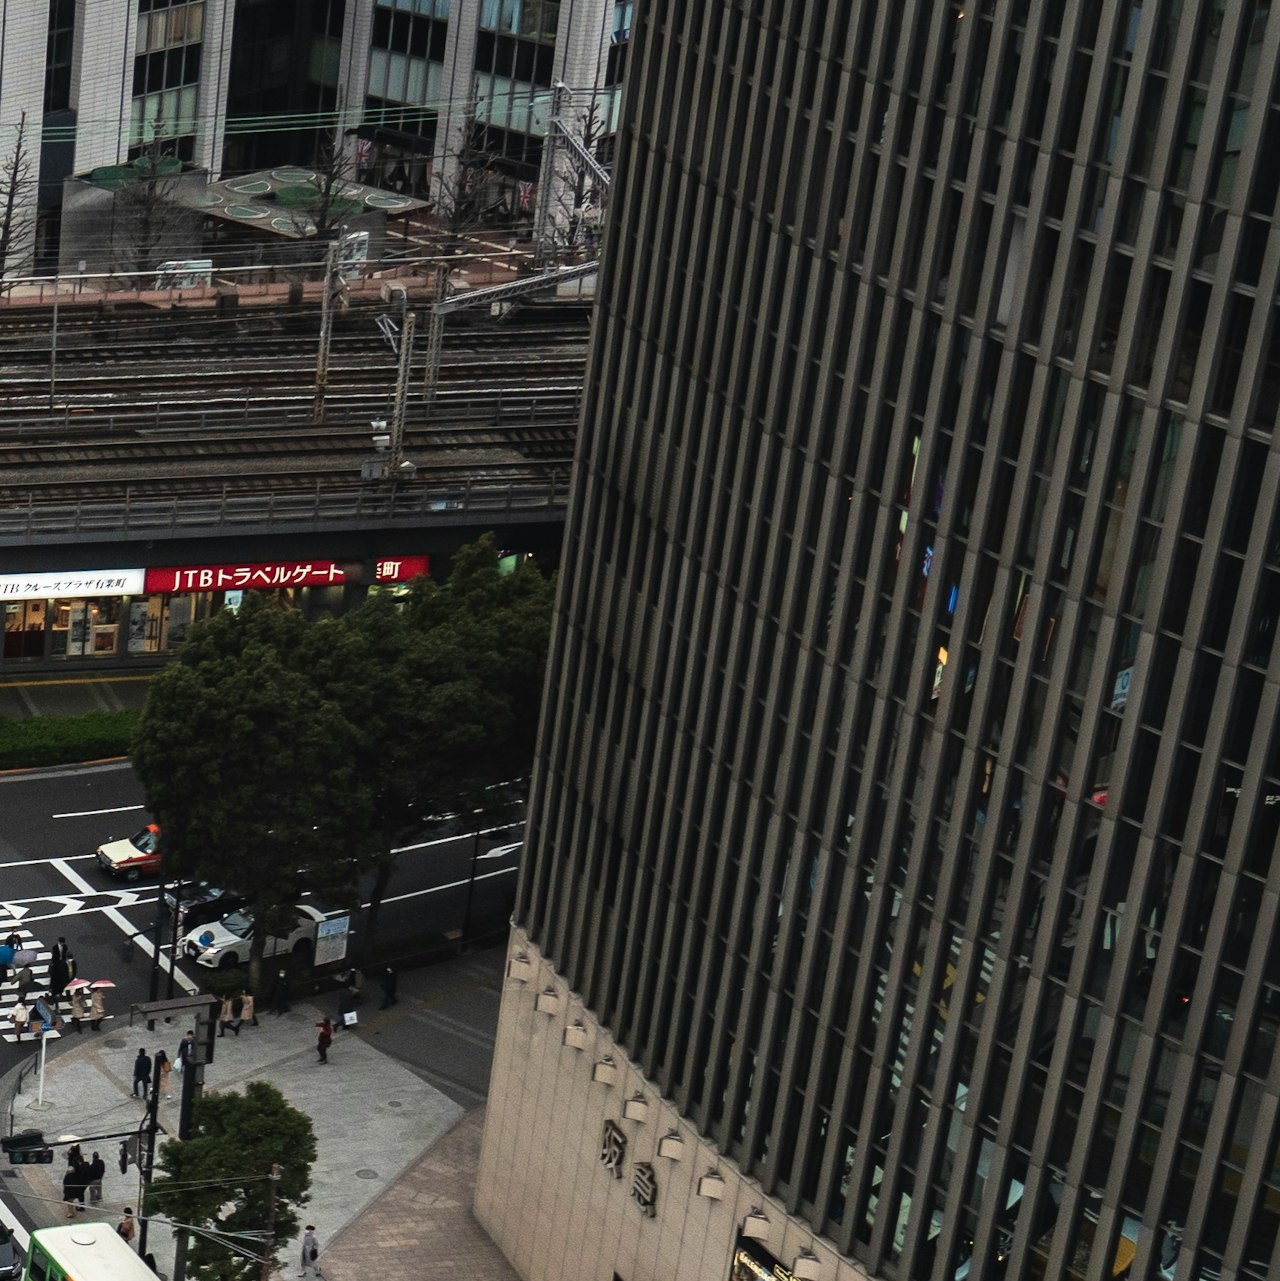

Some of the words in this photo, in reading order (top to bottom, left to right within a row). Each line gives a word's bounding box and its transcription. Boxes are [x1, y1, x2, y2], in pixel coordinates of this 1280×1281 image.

[172, 562, 344, 592] JTBトラベルゲート
[599, 1118, 658, 1219] 阪急
